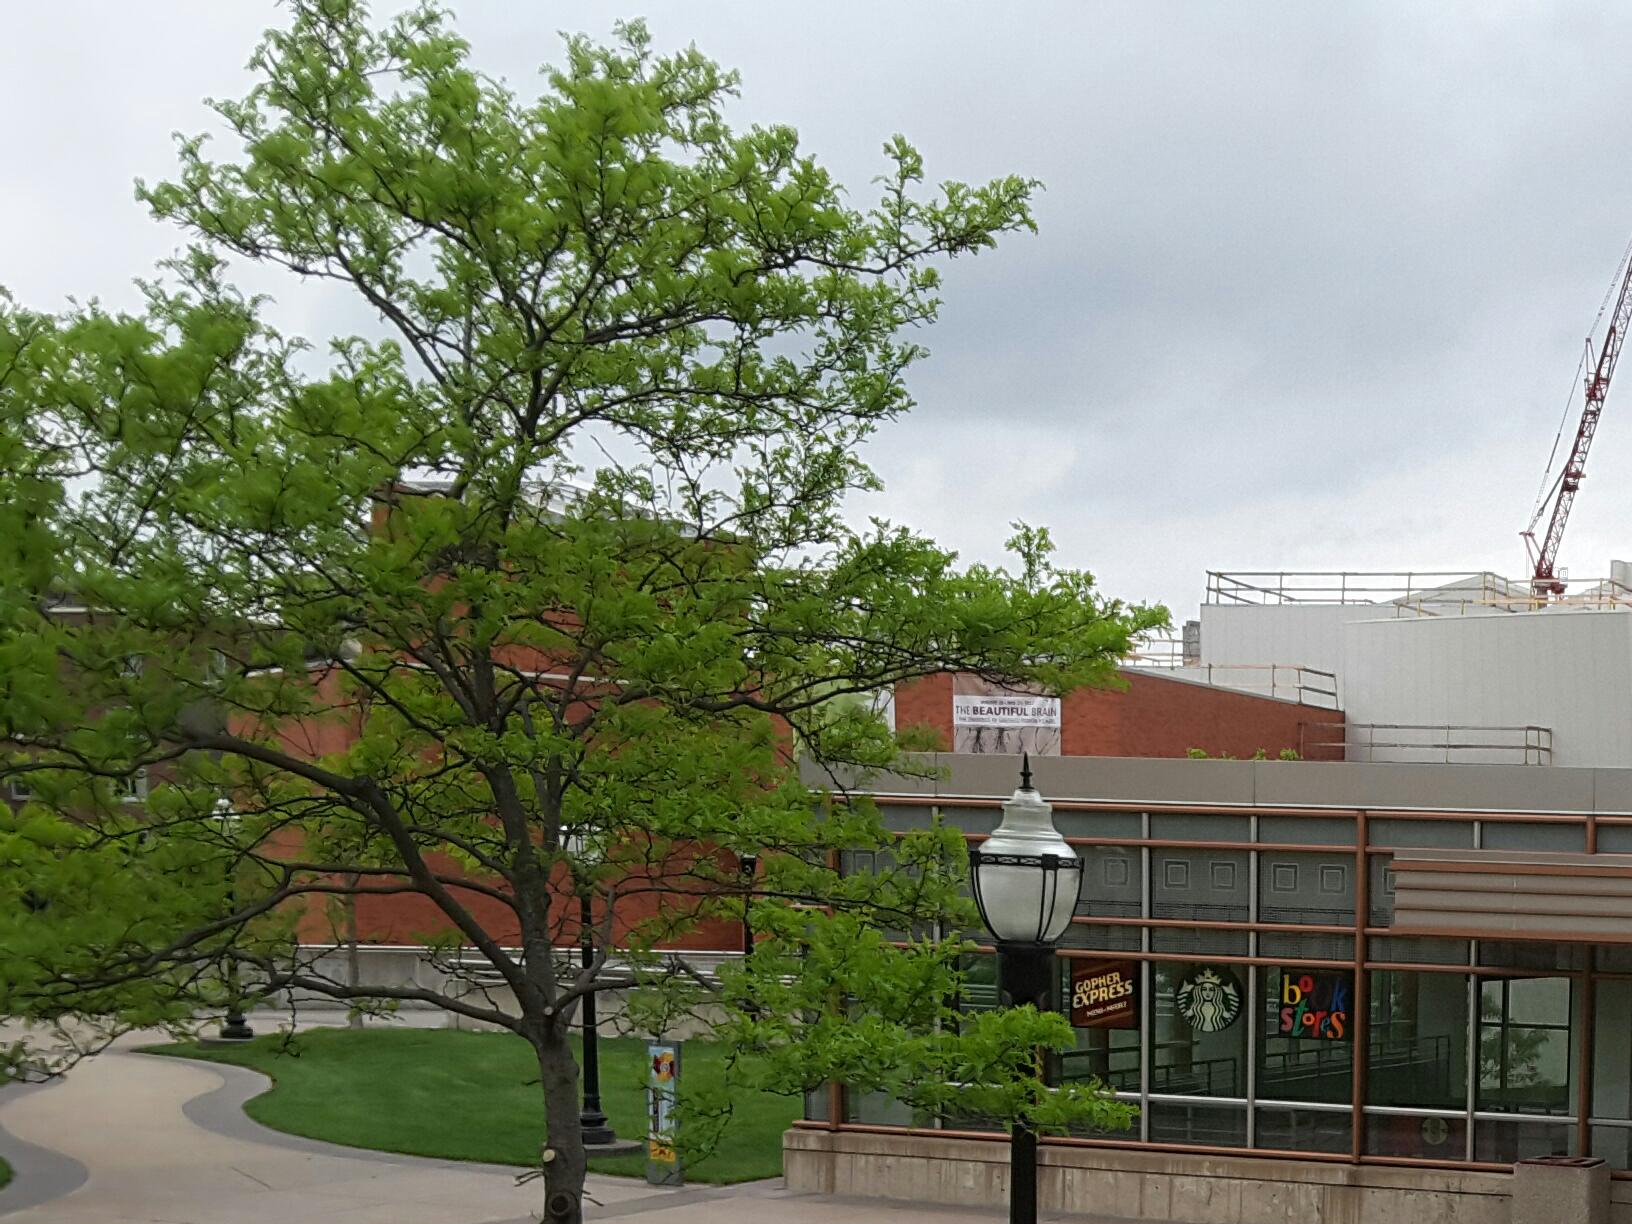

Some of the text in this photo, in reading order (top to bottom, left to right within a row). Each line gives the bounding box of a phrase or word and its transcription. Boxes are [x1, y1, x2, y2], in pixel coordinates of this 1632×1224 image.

[955, 705, 1057, 717] THE BEAUTIFUL BRAIN
[1072, 979, 1133, 1009] EXPRESS
[1075, 971, 1121, 993] GOPHER
[1283, 974, 1345, 1012] bok
